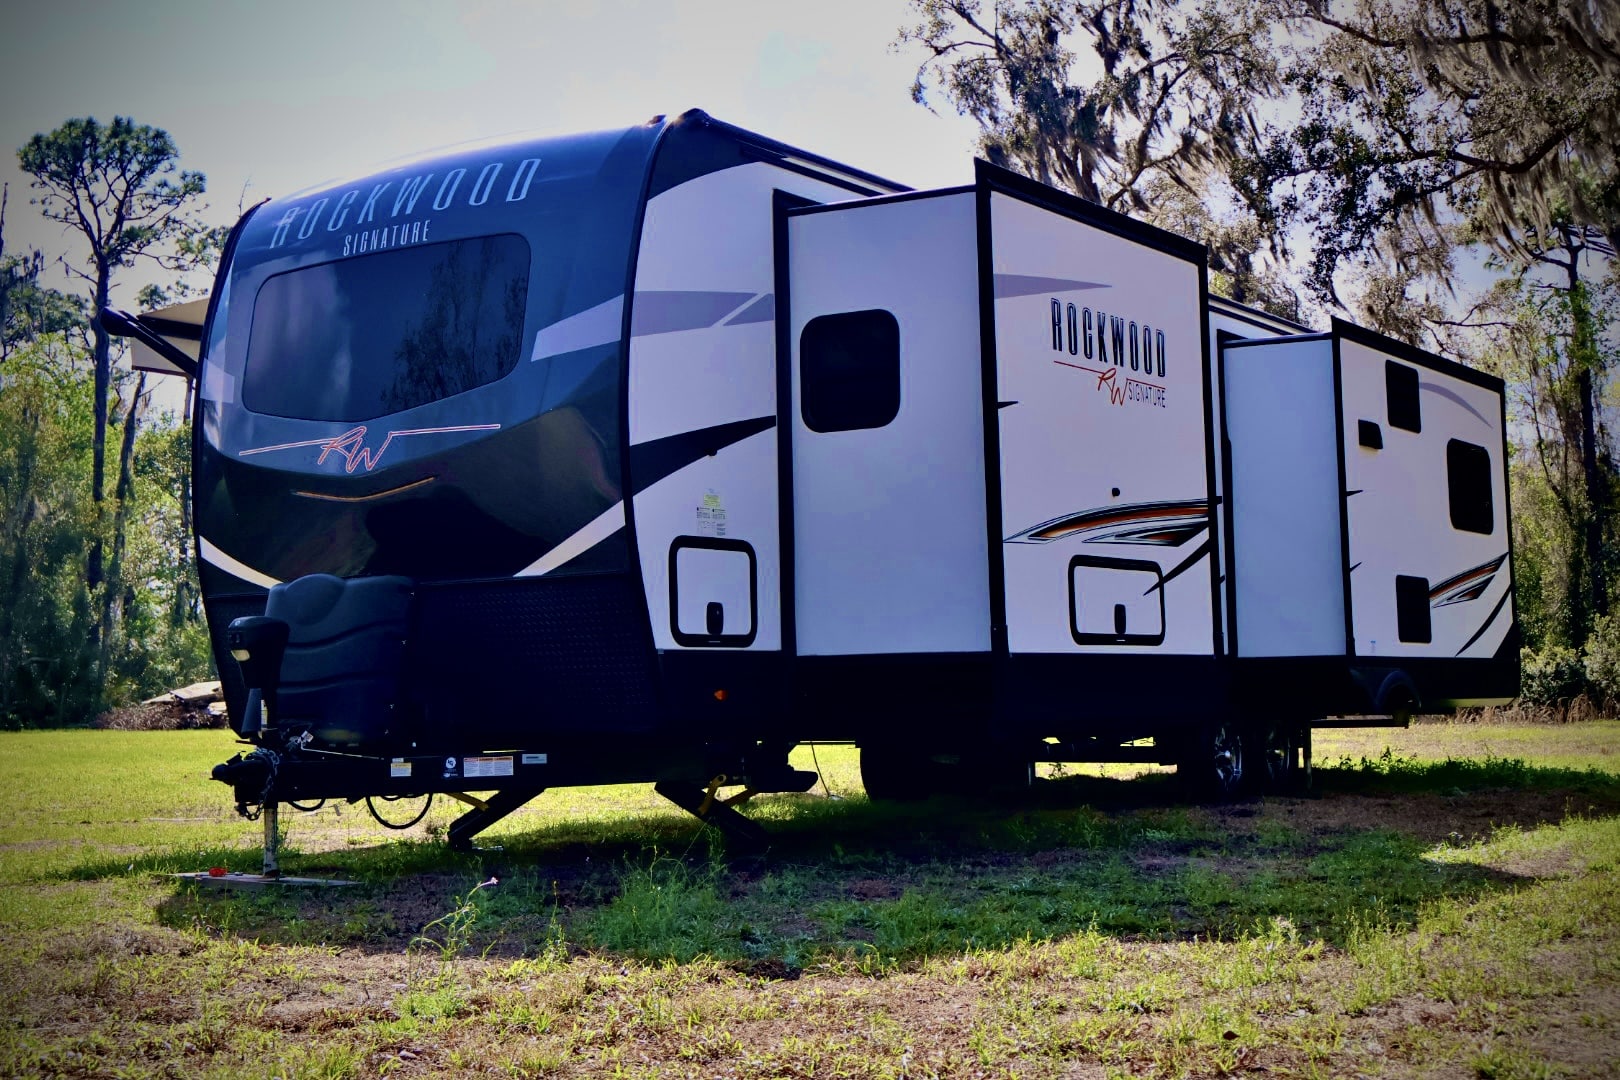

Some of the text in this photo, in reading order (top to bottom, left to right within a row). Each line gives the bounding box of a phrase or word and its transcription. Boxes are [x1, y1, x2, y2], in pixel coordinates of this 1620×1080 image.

[269, 158, 541, 249] ROCKWOOD
[343, 219, 431, 257] SIGNATURE
[1051, 297, 1166, 377] ROCKWOOD
[1097, 367, 1166, 408] RW SIGNATURE
[317, 426, 393, 473] RW
